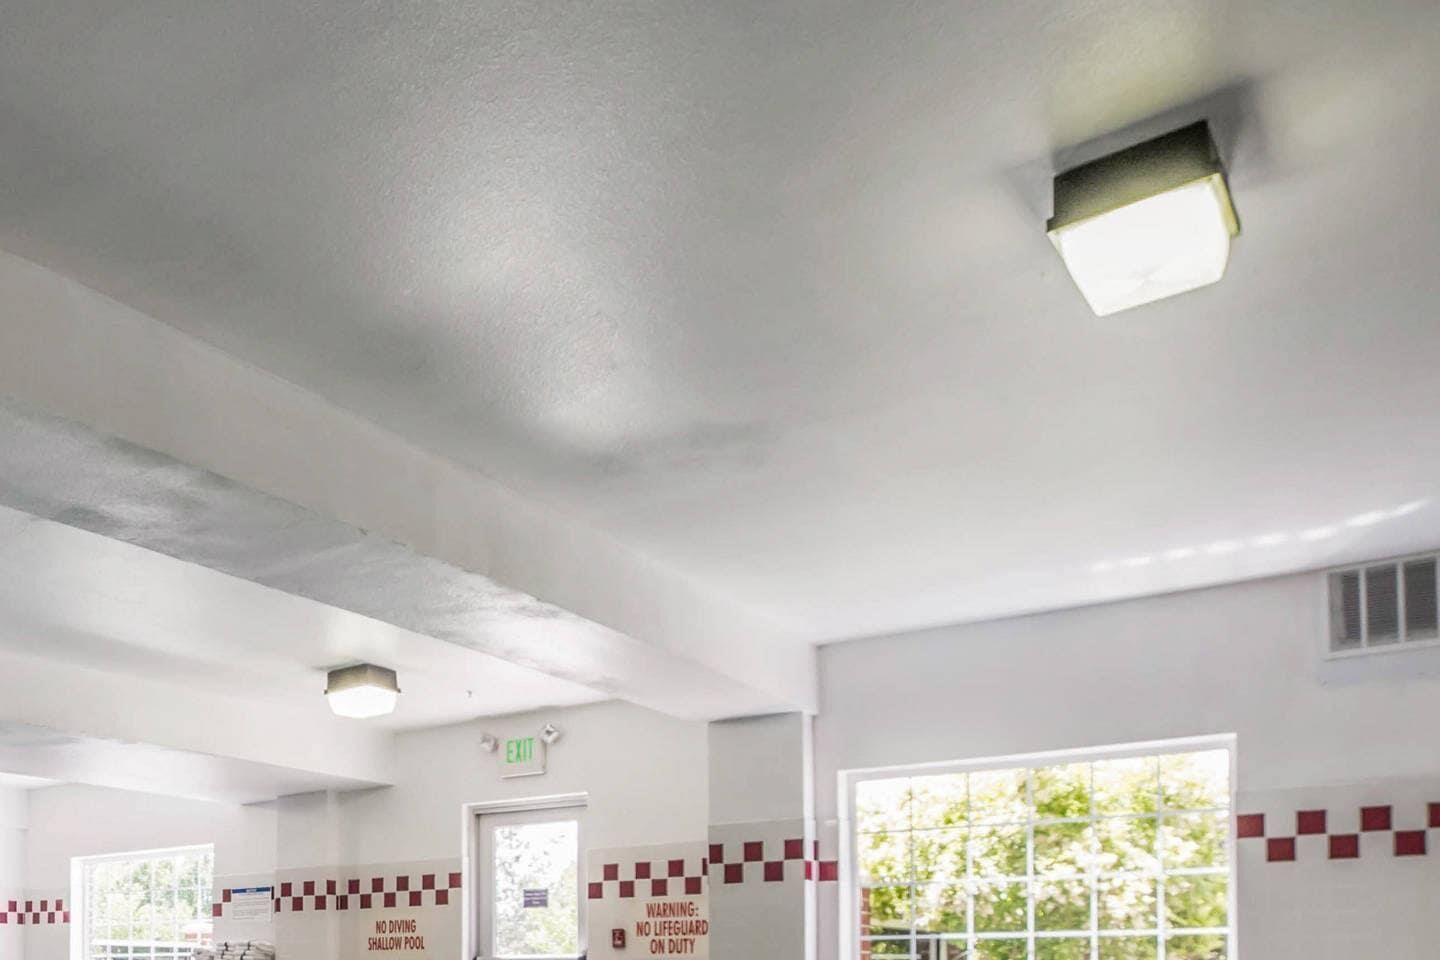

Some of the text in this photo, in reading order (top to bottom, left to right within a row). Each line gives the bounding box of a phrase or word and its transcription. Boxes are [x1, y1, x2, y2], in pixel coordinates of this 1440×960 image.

[506, 737, 535, 764] EXIT
[646, 901, 699, 918] WARNING:
[376, 919, 417, 934] NO DIVING
[636, 919, 709, 936] NO LIFEGUARD
[368, 936, 425, 951] SHALLOW POOL
[650, 938, 696, 954] ON DUTY
